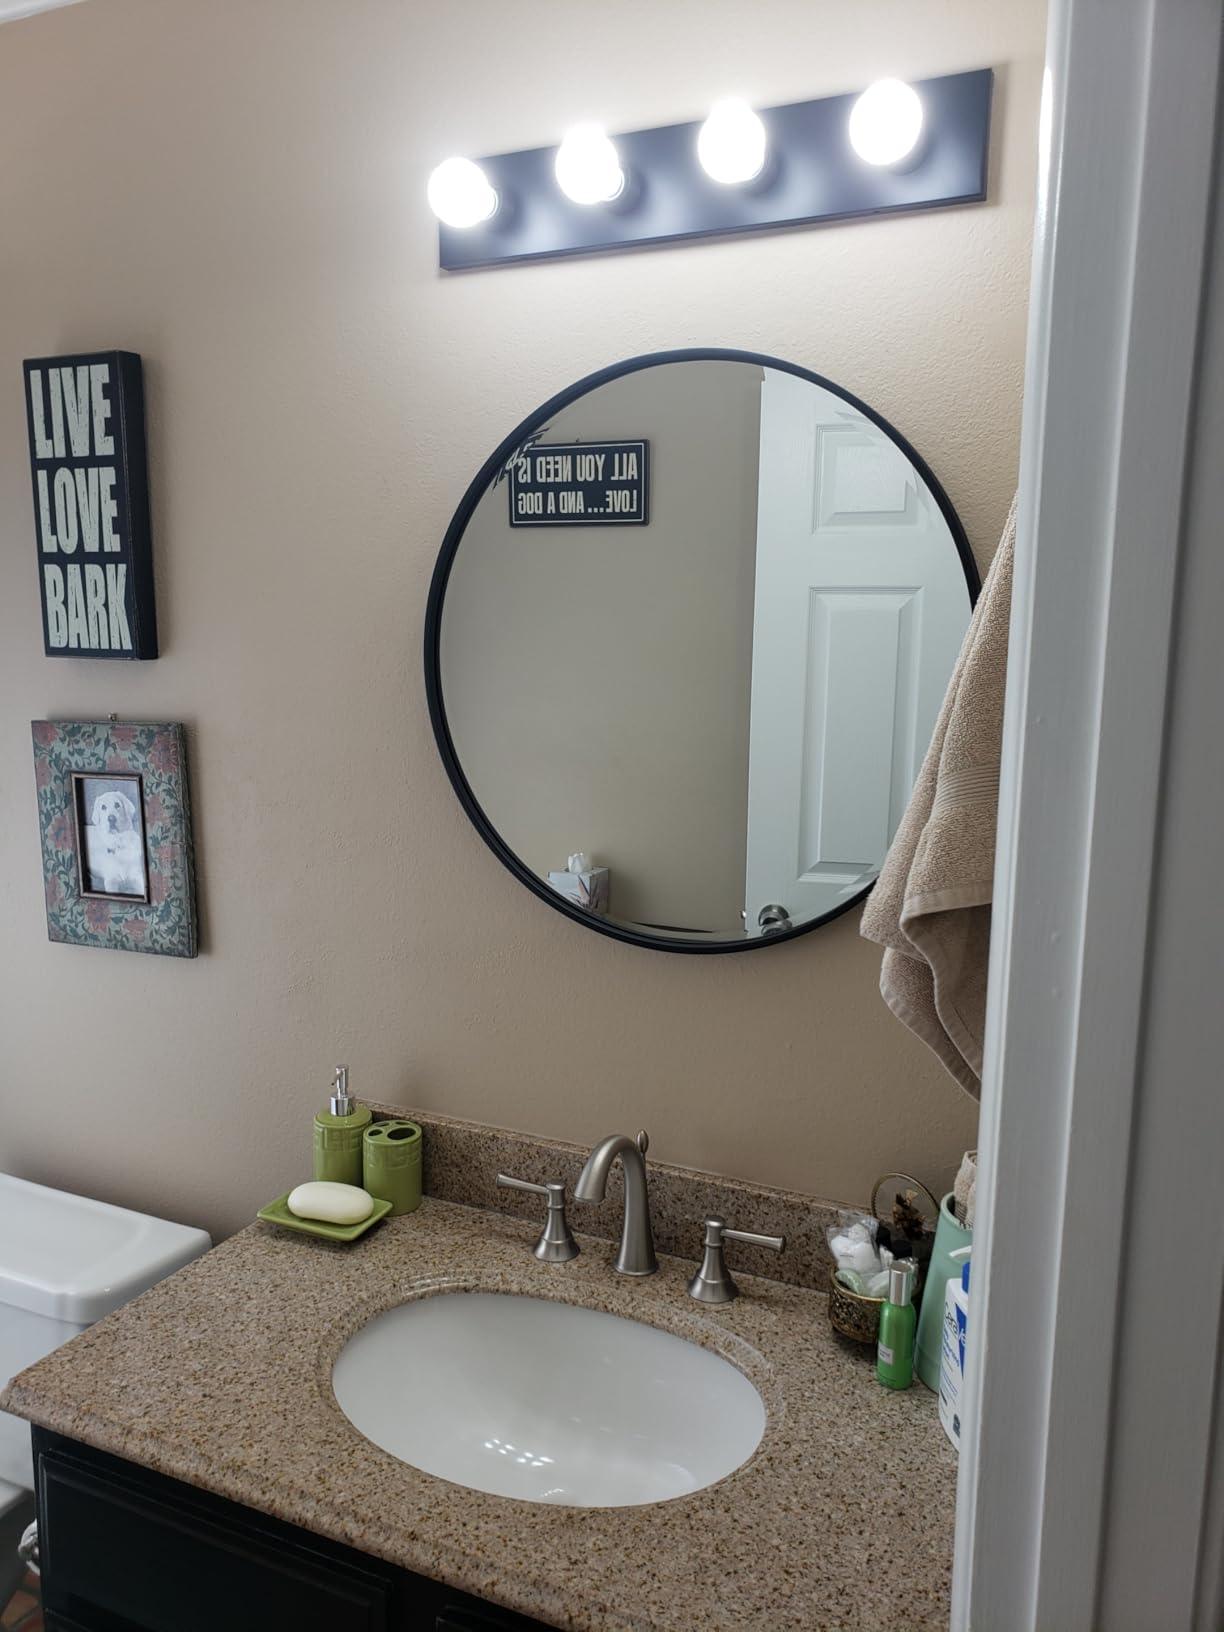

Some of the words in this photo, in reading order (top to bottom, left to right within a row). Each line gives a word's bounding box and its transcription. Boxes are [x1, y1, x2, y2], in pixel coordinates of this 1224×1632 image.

[29, 363, 115, 459] LIVE
[37, 466, 121, 554] LOVE
[43, 563, 133, 650] BARK
